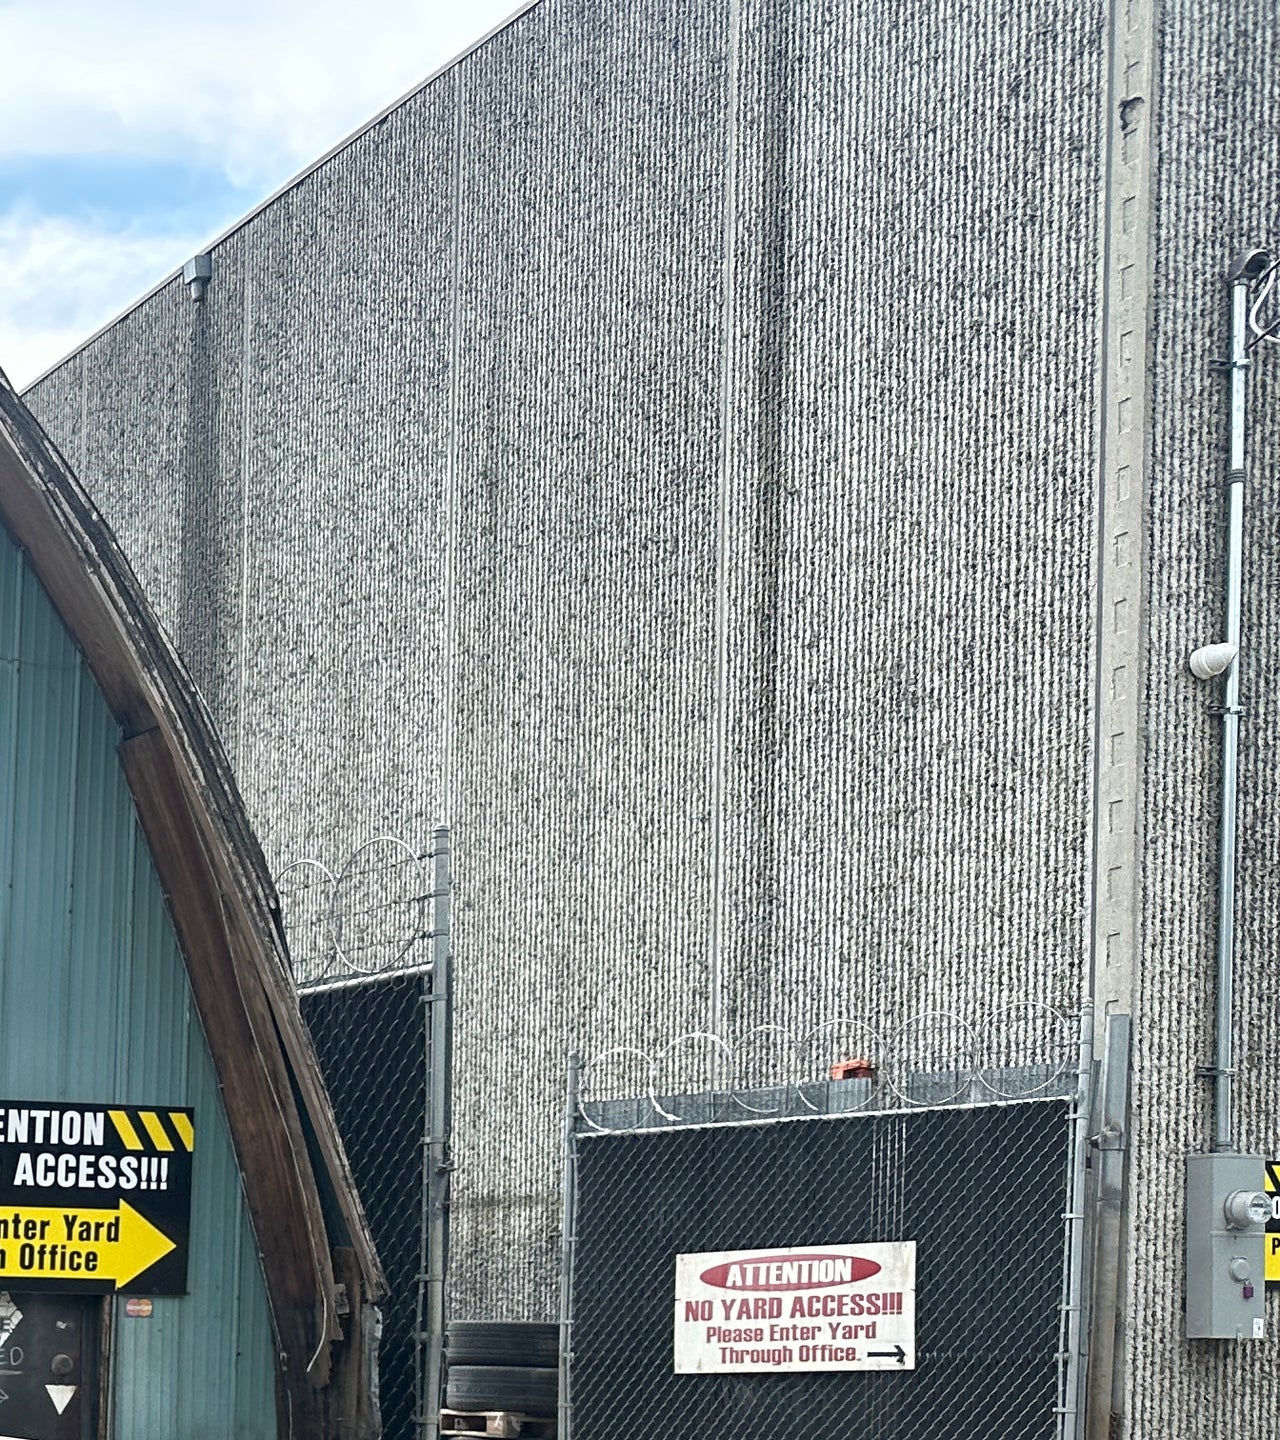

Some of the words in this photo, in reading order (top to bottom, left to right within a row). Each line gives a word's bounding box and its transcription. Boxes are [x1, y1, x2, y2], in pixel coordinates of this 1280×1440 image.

[13, 1153, 169, 1190] ACCESS!!!
[63, 1214, 120, 1243] Yard
[18, 1243, 99, 1272] Office
[725, 1258, 853, 1287] ATTENTION
[684, 1300, 714, 1322] NO
[720, 1296, 783, 1321] YARD
[789, 1292, 904, 1319] ACCESS!!!
[705, 1326, 764, 1344] Please
[769, 1324, 822, 1342] Enter
[828, 1321, 877, 1340] Yard
[719, 1346, 793, 1366] Through
